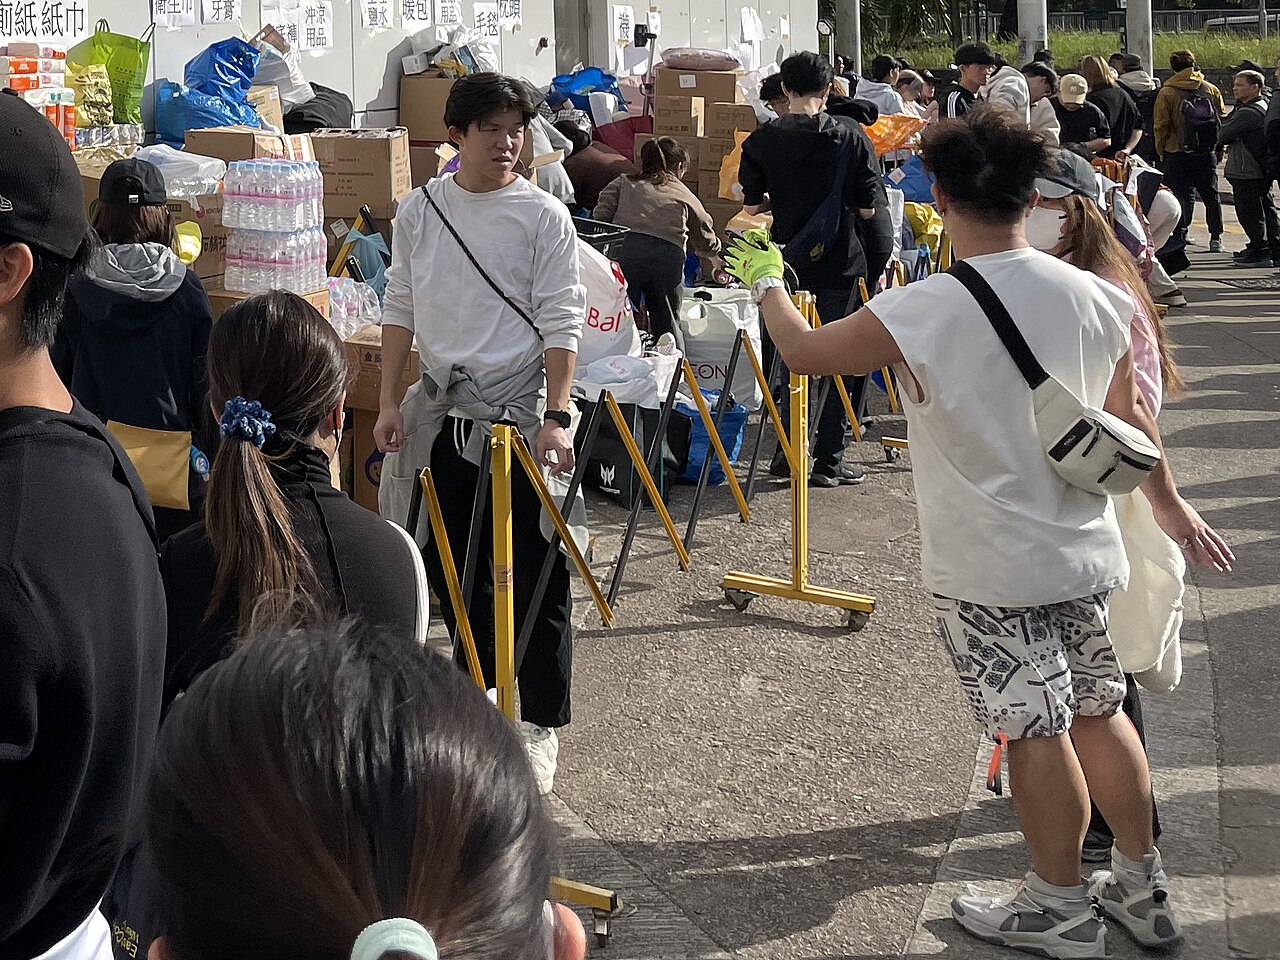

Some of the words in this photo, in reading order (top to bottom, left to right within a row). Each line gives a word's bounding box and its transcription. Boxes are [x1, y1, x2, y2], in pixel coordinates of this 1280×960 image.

[211, 0, 235, 21] 牙膏
[440, 5, 458, 24] 用品
[306, 27, 327, 47] 用品
[690, 363, 727, 379] EON
